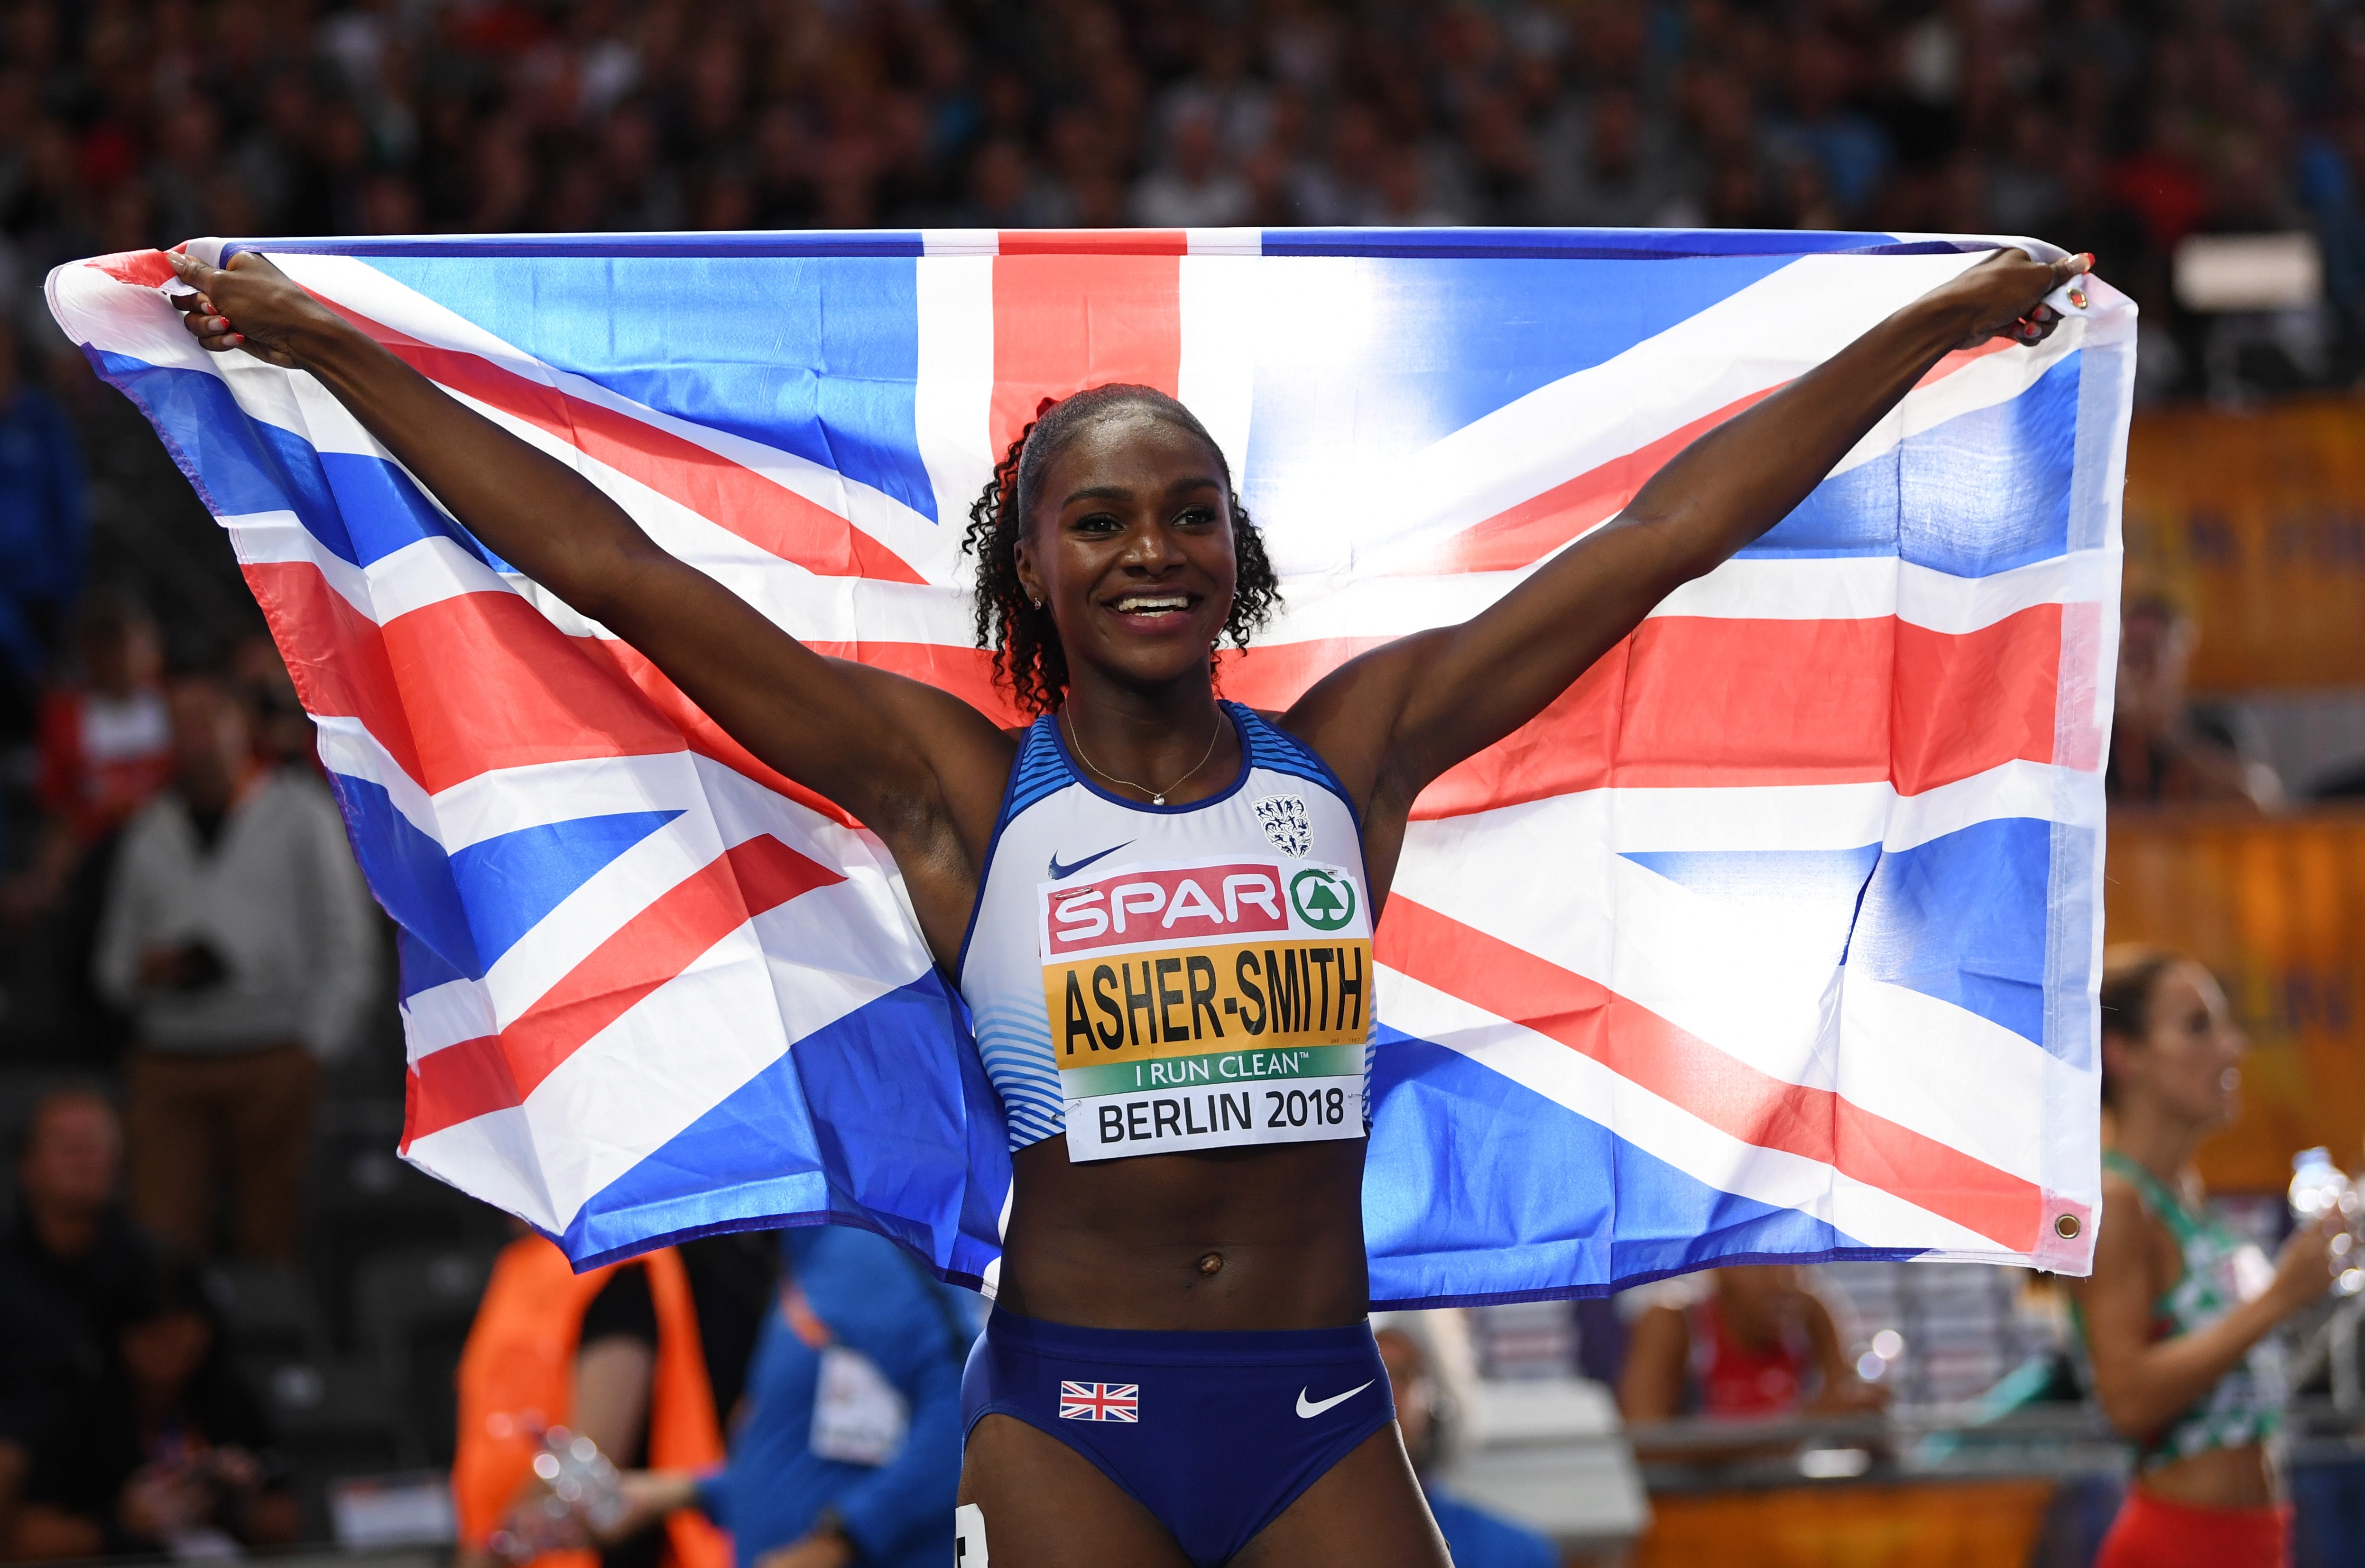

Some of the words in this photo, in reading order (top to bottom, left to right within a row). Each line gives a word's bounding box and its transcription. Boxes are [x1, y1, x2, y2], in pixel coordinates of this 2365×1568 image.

[1055, 873, 1280, 942] SPAR
[1066, 947, 1362, 1055] ASHER-SMITH
[1136, 1065, 1141, 1087] I
[1151, 1059, 1210, 1085] RUN
[1099, 1092, 1252, 1144] BERLIN
[1266, 1088, 1344, 1128] 2018
